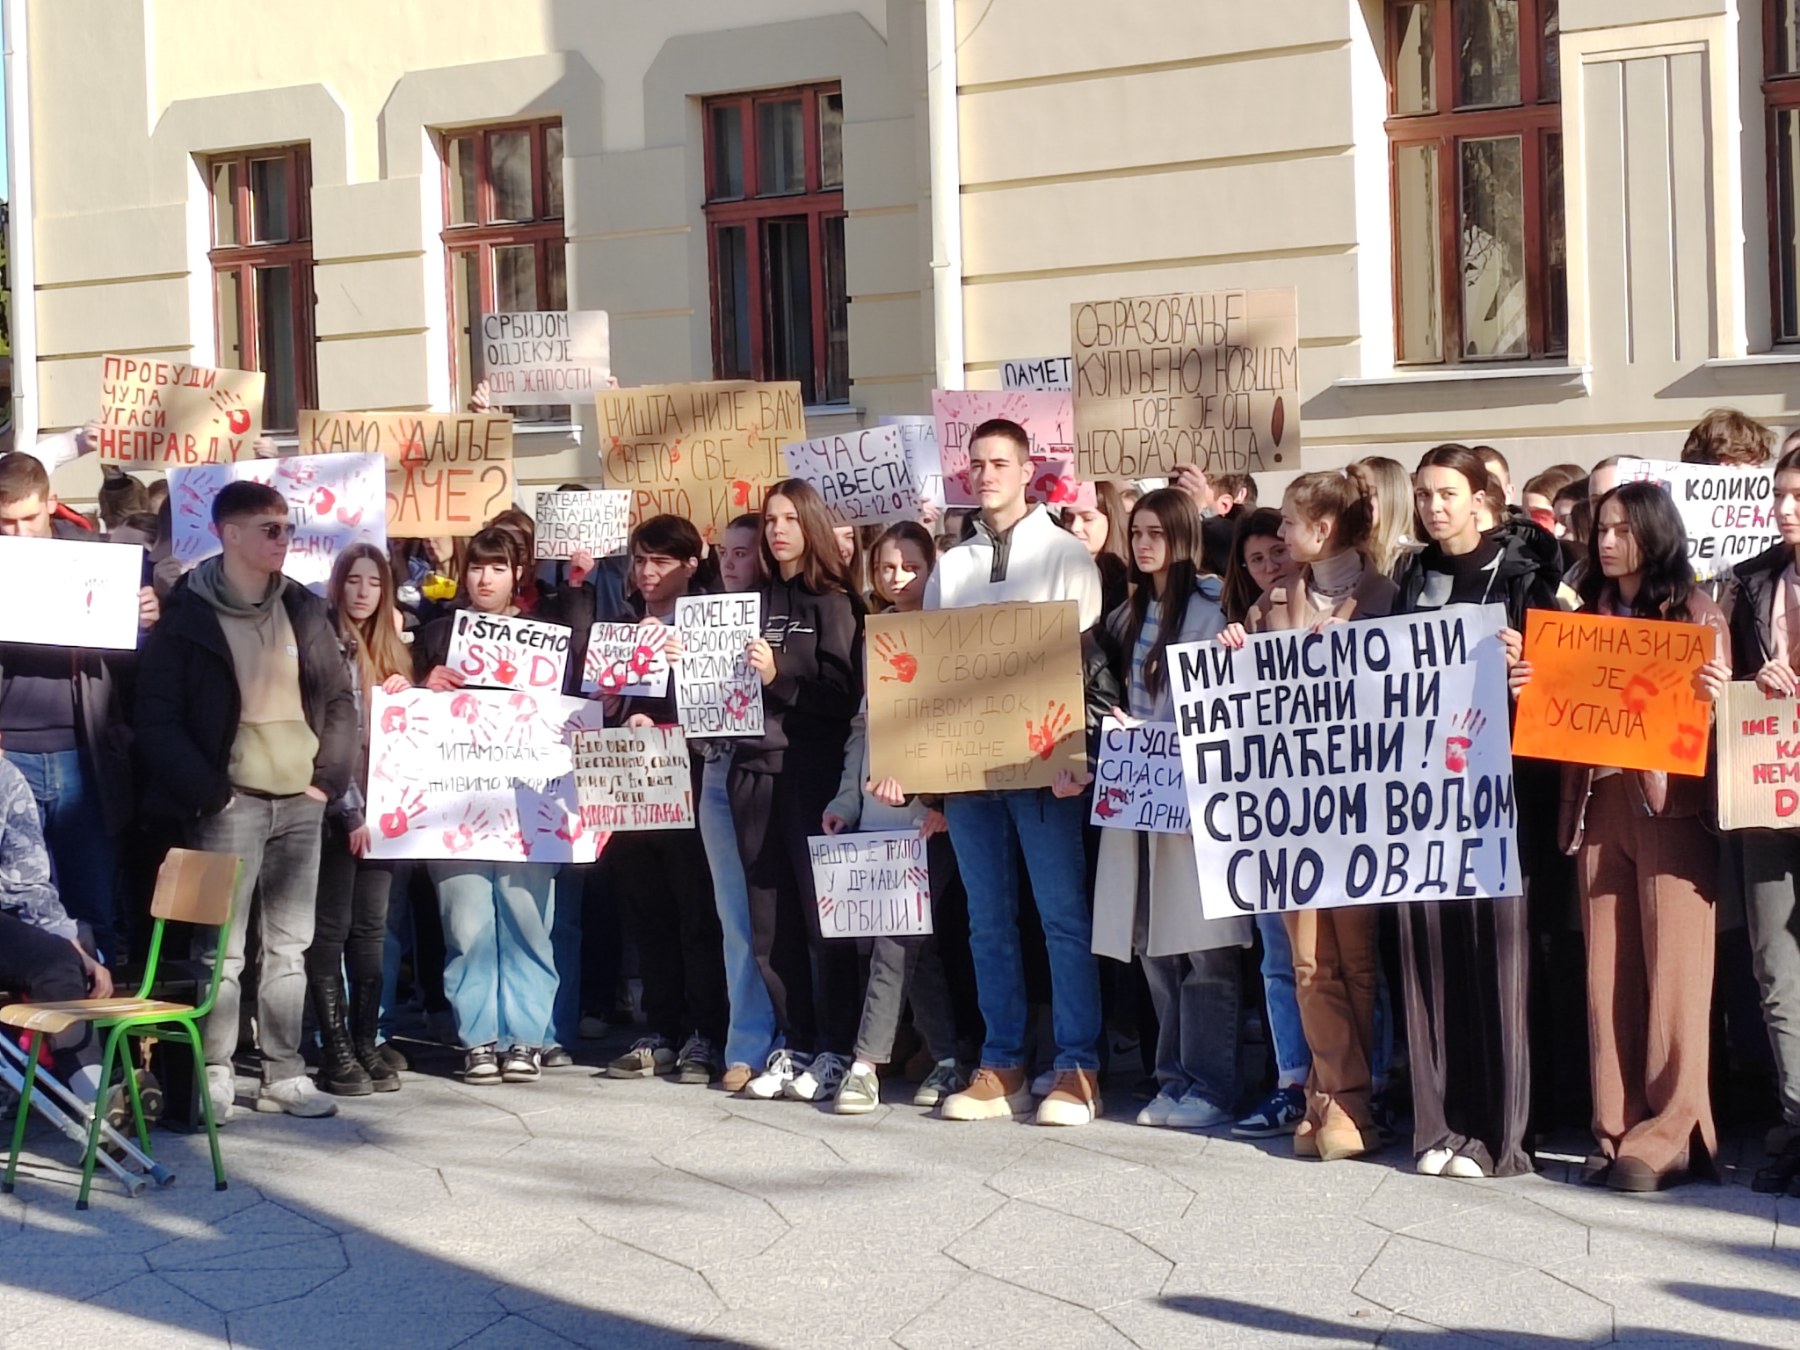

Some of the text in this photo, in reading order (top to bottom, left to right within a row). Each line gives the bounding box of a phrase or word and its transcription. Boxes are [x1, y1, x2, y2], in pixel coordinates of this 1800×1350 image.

[485, 314, 569, 339] СРБИЈОМ
[1076, 294, 1243, 347] ОБРАЗОВАЊЕ
[488, 340, 573, 365] ОДЈЕКУЈЕ
[103, 357, 216, 390] ПРОБУДИ
[490, 371, 515, 393] ОДА
[1004, 357, 1072, 387] ПАМЕТ
[1076, 347, 1201, 398] КУПЉЕНО
[102, 386, 162, 407] ЧУЛА
[1127, 393, 1252, 430] ГОРЕ ЈЕ ОД
[101, 405, 166, 428] УГАСИ
[604, 389, 802, 437] НИШТА НИЈЕ ВАМ
[101, 429, 243, 464] НЕПРАВДУ
[309, 417, 509, 467] КАМО ДАЉЕ
[809, 431, 877, 470] ЧАС
[1077, 428, 1264, 475] НЕОБРАЗОВАЊА
[691, 438, 736, 481] СВЕ
[759, 437, 789, 478] ЈЕ
[1685, 475, 1770, 502] КОЛИКО
[580, 507, 602, 523] ДА
[628, 487, 692, 529] РУТО
[536, 522, 620, 541] ОТВОРИЛИ
[734, 599, 755, 626] JE
[473, 615, 511, 641] ŠTA
[516, 624, 571, 652] ĆEMO
[919, 608, 1065, 654] МИСЛИ
[1535, 621, 1709, 663] ГИМНАЗИЈА
[937, 651, 1046, 684] СВОЈОМ
[1179, 617, 1467, 693] МИ НИСМО НИ
[1592, 666, 1626, 690] ЈЕ
[893, 694, 1033, 719] ГЛАВОМ ДОК
[1180, 671, 1440, 737] НАТЕРАНИ НИ
[1547, 696, 1647, 742] УСТАЛА
[926, 720, 985, 738] НЕШТО
[1742, 716, 1779, 735] IME
[904, 740, 1005, 759] НЕ ПАДНЕ
[945, 762, 973, 784] НА
[1100, 759, 1184, 790] СПАСИ
[1135, 801, 1191, 829] ДРЖ
[1204, 774, 1514, 842] СВОЈОМ ВОЉОМ
[811, 841, 858, 865] НЕШТО
[825, 868, 907, 893] У ДРЖАВИ
[1227, 847, 1324, 912] СМО
